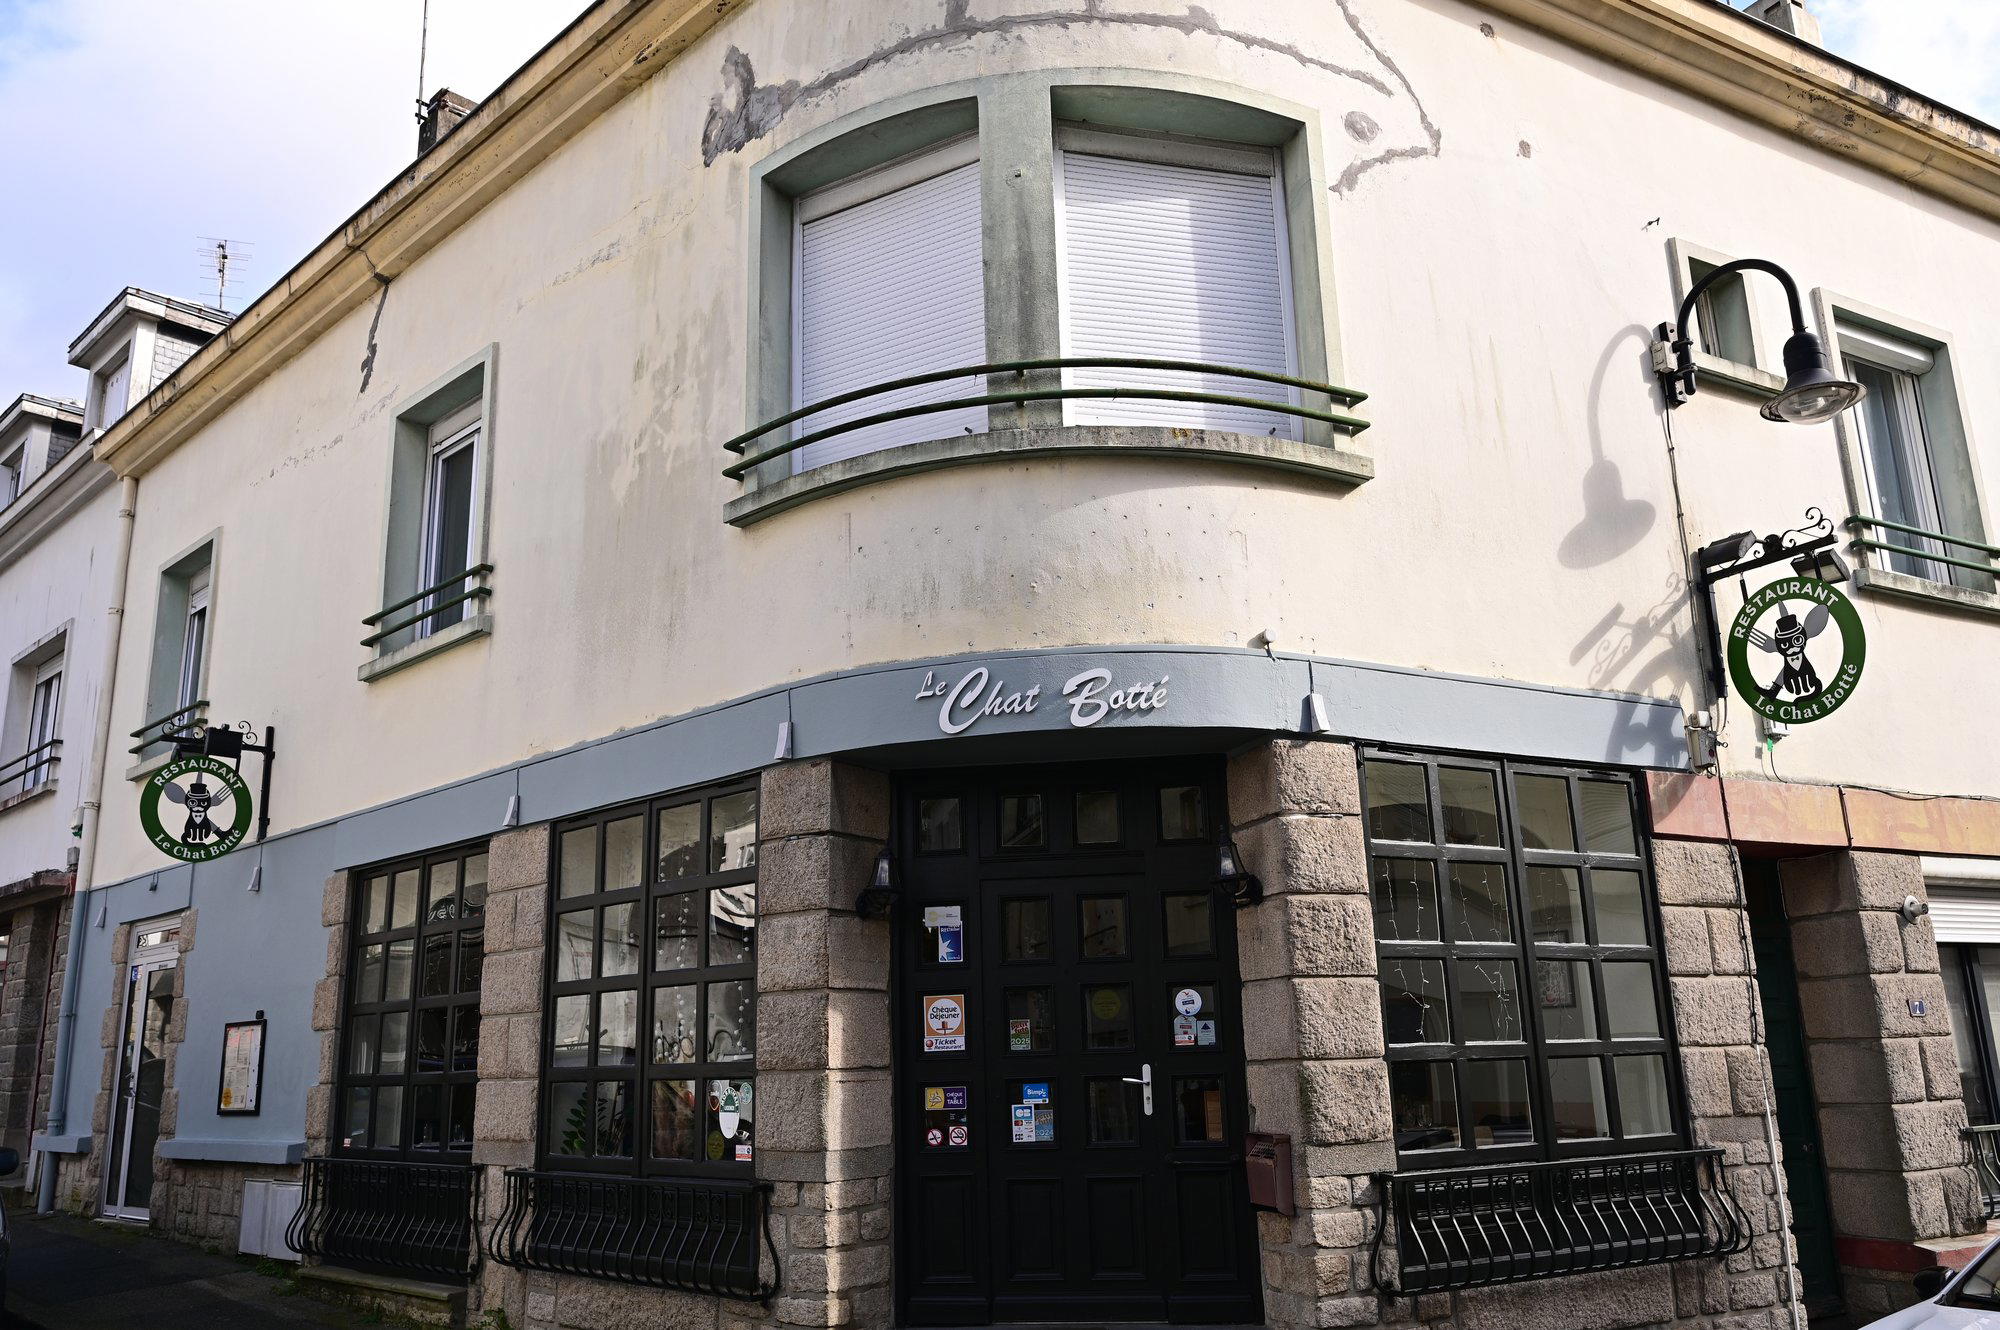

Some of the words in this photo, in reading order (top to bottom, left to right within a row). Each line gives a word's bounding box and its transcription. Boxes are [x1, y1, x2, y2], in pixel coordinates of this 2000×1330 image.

[1733, 581, 1839, 639] RESTAURANT
[915, 671, 947, 700] Le
[938, 667, 1041, 734] Chat
[1062, 667, 1170, 728] Botté
[1754, 695, 1775, 714] Le
[1780, 703, 1821, 720] Chat
[1821, 663, 1858, 709] Botté
[153, 759, 243, 790] RESTAURANT
[155, 833, 171, 849] Le
[173, 846, 206, 859] Chat
[210, 829, 242, 856] Botté
[929, 1012, 960, 1020] Déjeuner
[931, 1005, 958, 1014] Chèque
[1914, 1001, 1921, 1014] 7
[934, 1038, 957, 1046] Ticket
[1011, 1037, 1031, 1046] 2025
